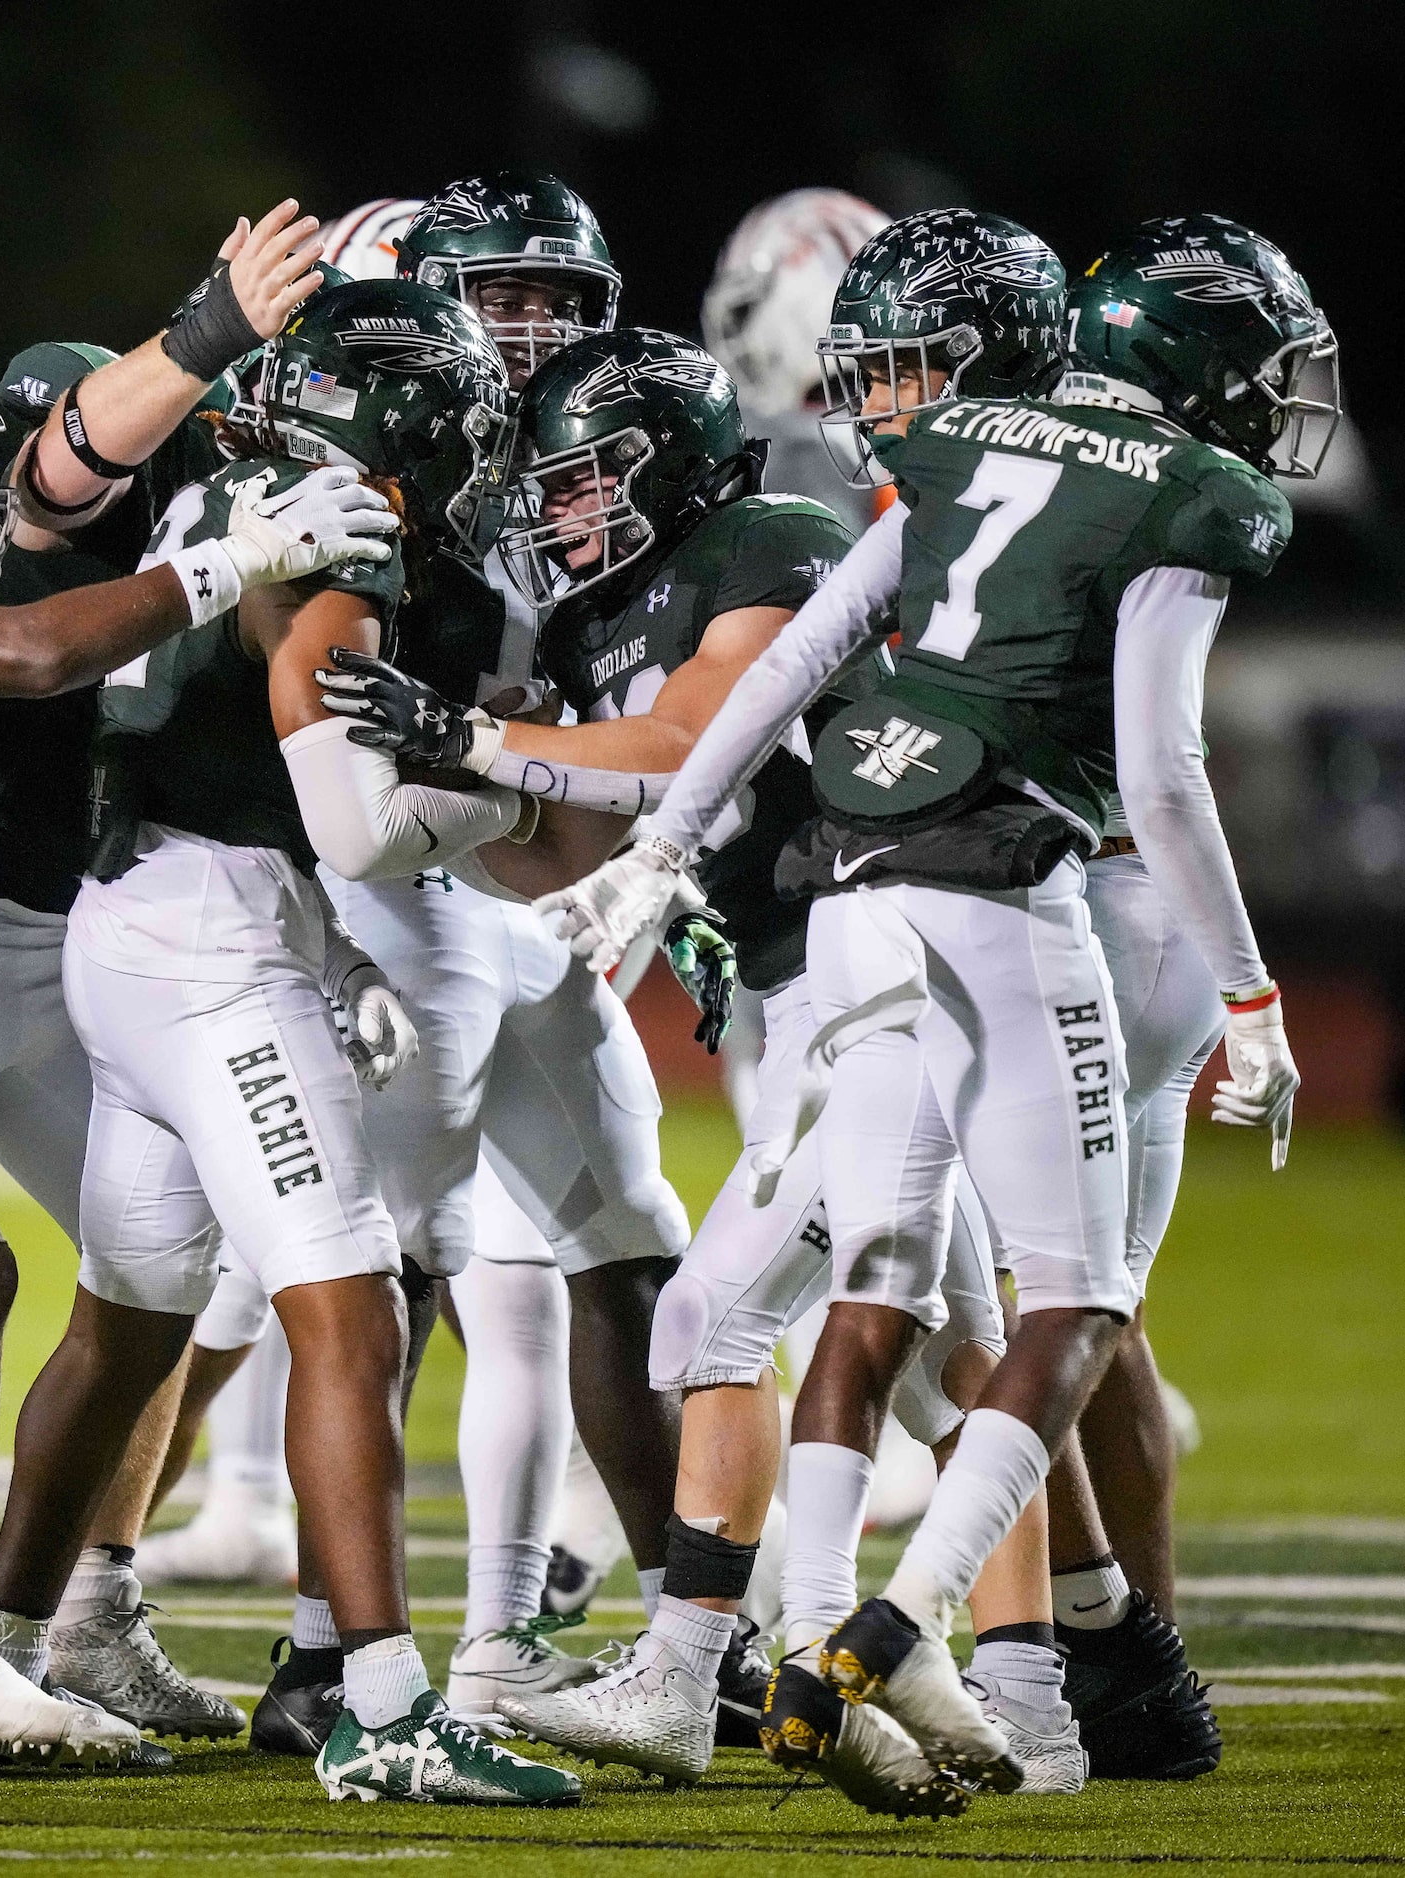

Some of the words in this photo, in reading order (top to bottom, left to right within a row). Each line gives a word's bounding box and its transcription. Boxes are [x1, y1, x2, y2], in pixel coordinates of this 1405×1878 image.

[1154, 249, 1224, 265] INDIANS
[352, 317, 421, 333] INDIANS
[1067, 307, 1082, 353] 7
[65, 408, 86, 447] NXTRND
[289, 433, 328, 461] ROPE
[929, 401, 1174, 482] E.THOMPSON
[916, 449, 1065, 663] 7
[590, 634, 647, 688] INDIANS
[1055, 1000, 1118, 1163] HACHIE
[226, 1041, 325, 1199] HACHIE
